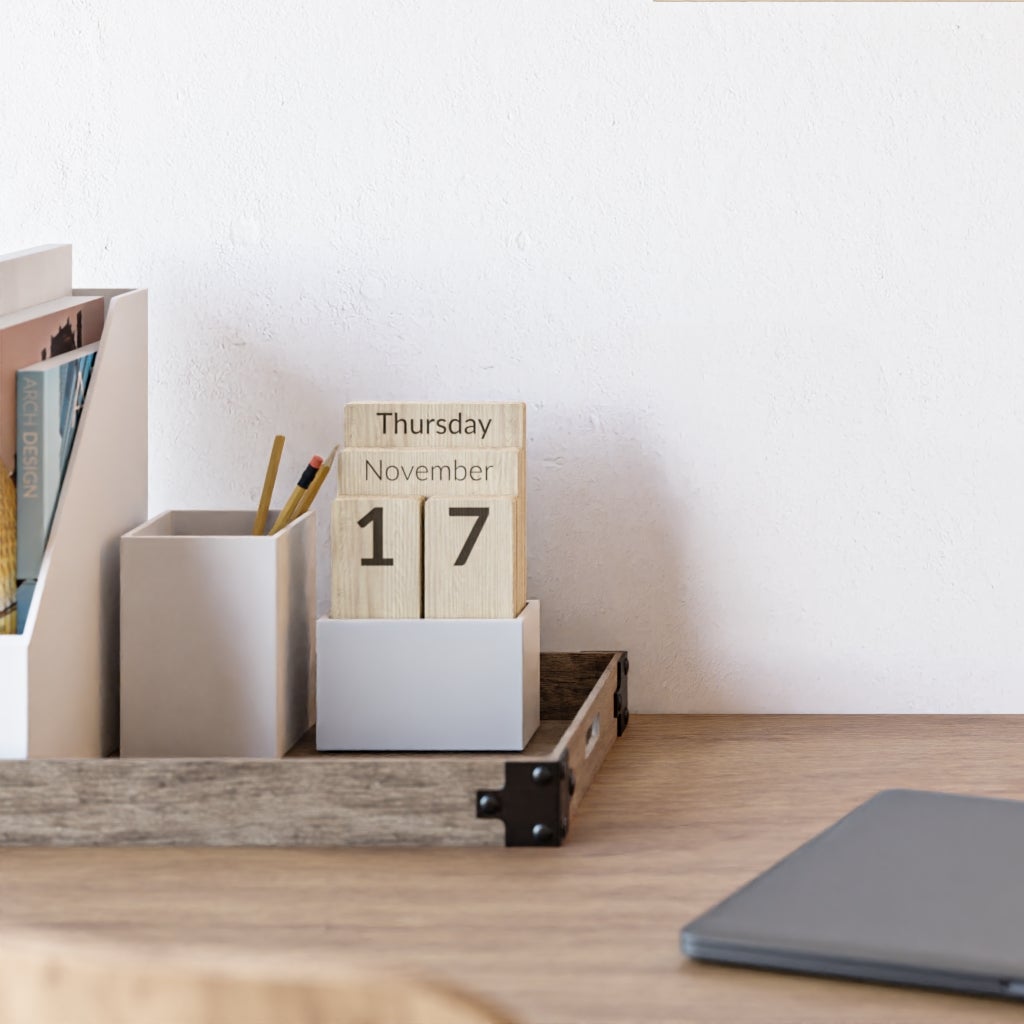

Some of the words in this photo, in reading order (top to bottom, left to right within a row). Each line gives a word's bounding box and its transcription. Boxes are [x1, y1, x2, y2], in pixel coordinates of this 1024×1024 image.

[22, 376, 38, 426] ARCH
[376, 412, 492, 439] Thursday
[22, 430, 39, 499] DESIGN
[365, 459, 494, 481] November
